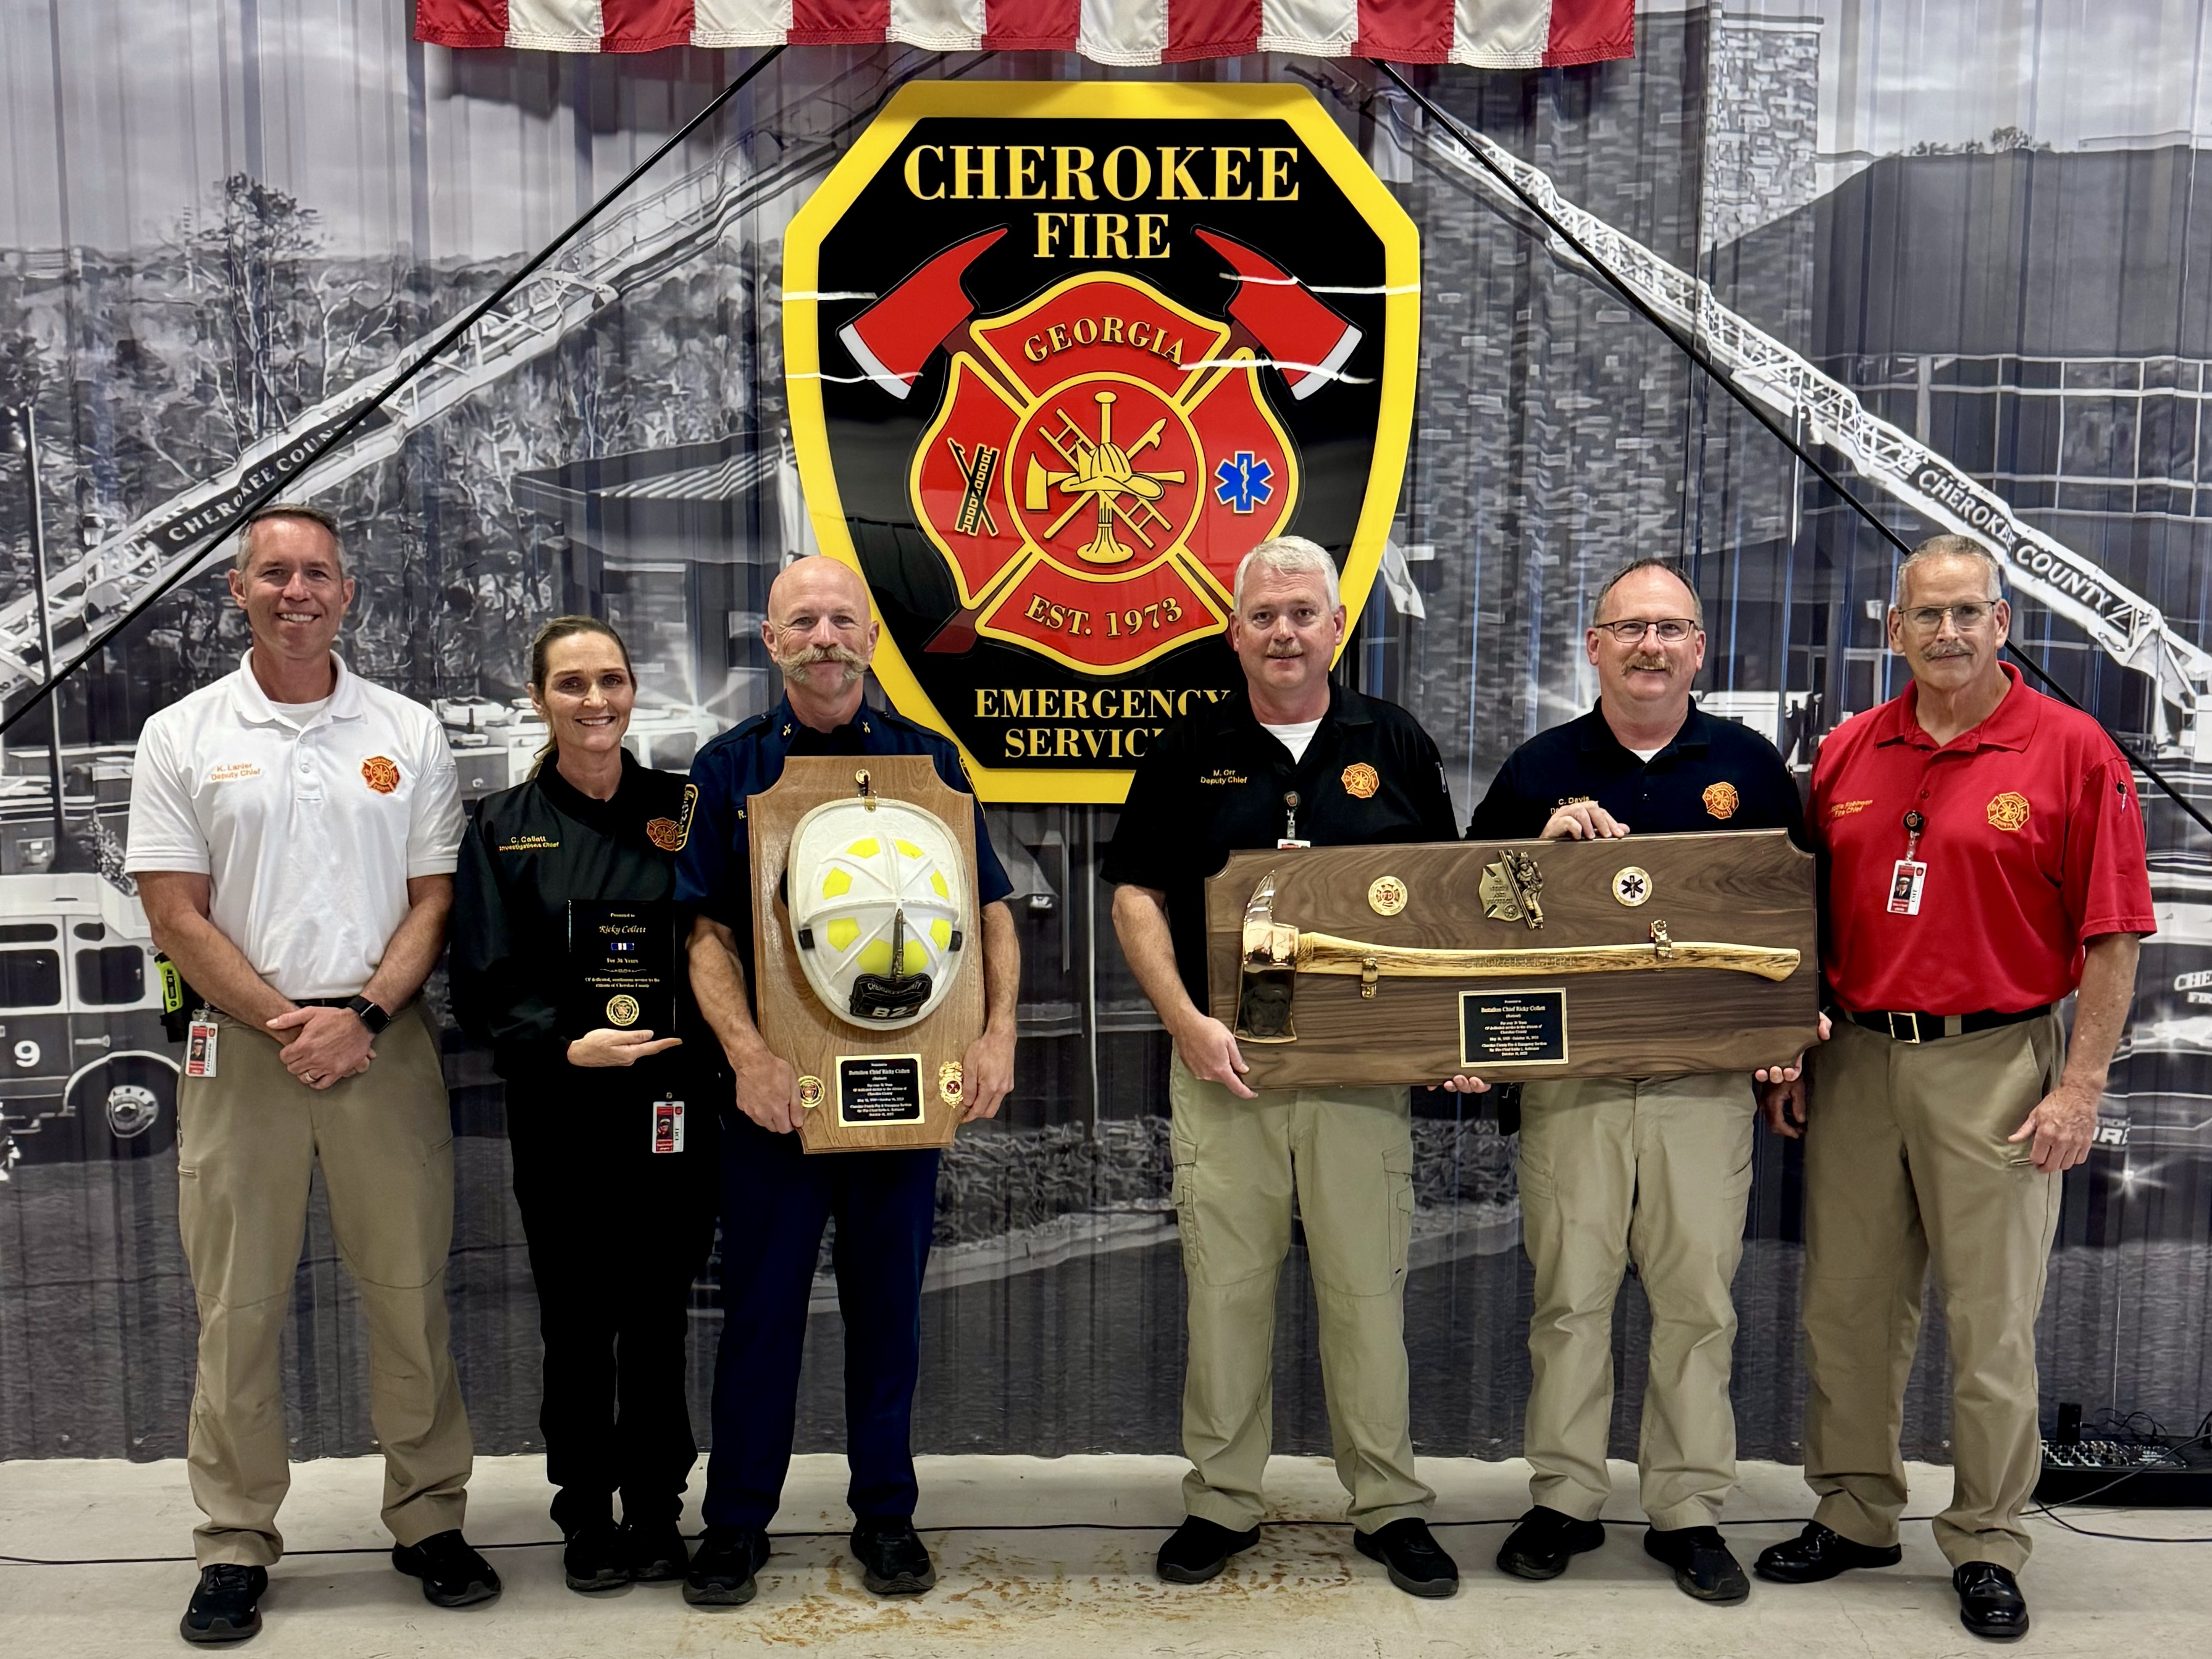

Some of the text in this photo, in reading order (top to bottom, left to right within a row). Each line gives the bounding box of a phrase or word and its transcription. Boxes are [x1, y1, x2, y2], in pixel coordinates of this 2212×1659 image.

[904, 145, 1300, 202] CHEROKEE
[1033, 212, 1171, 259] FIRE
[1023, 317, 1186, 366] GEORGIA
[169, 416, 367, 541] CHEROKEE COUN
[1918, 469, 2112, 611] CHEROKEE COUNTY
[1024, 594, 1184, 637] EST. 1973
[1005, 727, 1164, 758] SERVIC
[211, 767, 261, 780] Deputy Chief
[227, 763, 252, 771] Lanier
[1213, 769, 1222, 777] M.
[1200, 775, 1247, 785] Deputy Chief
[1568, 795, 1590, 804] Davis
[737, 809, 747, 820] R.
[1383, 892, 1393, 900] FD
[871, 1006, 907, 1018] B2
[14, 1040, 41, 1067] 9
